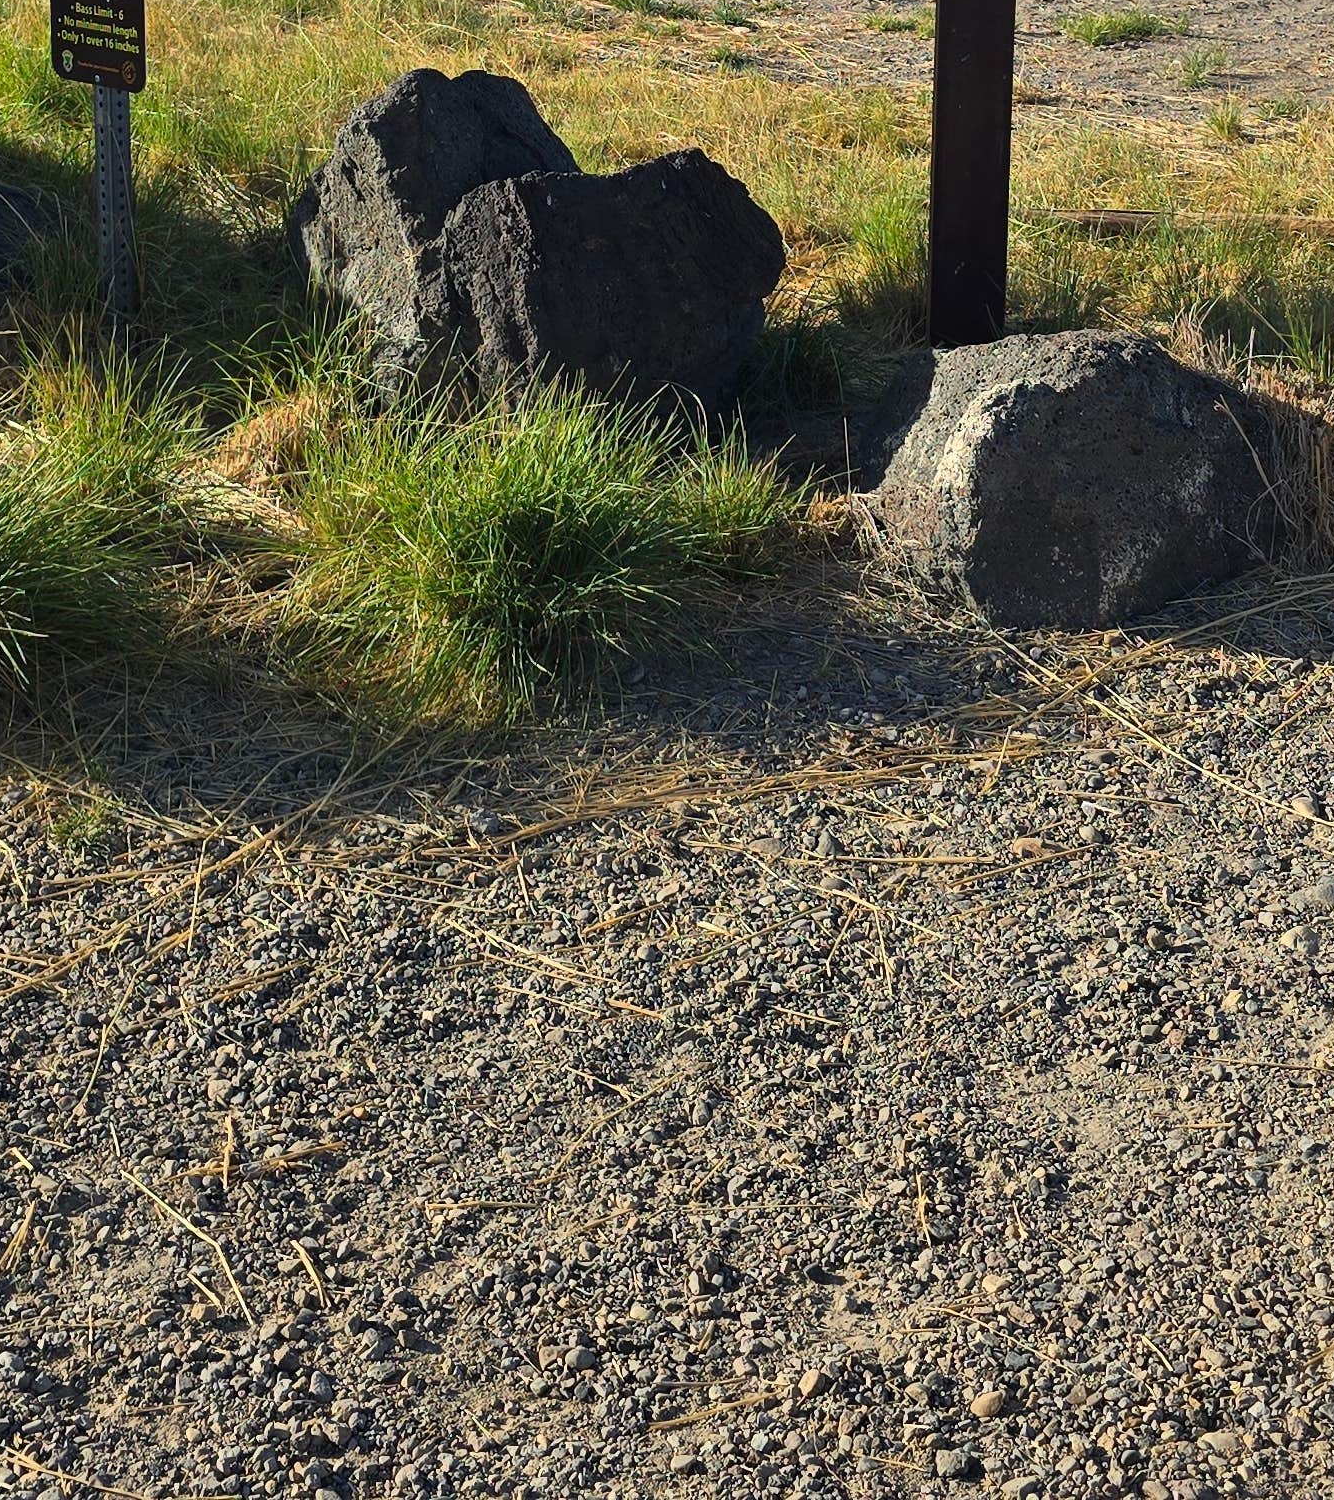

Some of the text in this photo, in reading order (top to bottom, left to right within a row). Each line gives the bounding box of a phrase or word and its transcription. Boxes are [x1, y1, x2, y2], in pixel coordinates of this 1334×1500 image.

[76, 2, 92, 14] Bass
[94, 5, 113, 18] Limit
[119, 10, 123, 20] 6
[64, 15, 137, 39] No minimum length
[62, 30, 139, 53] Only 1 over 16 inches
